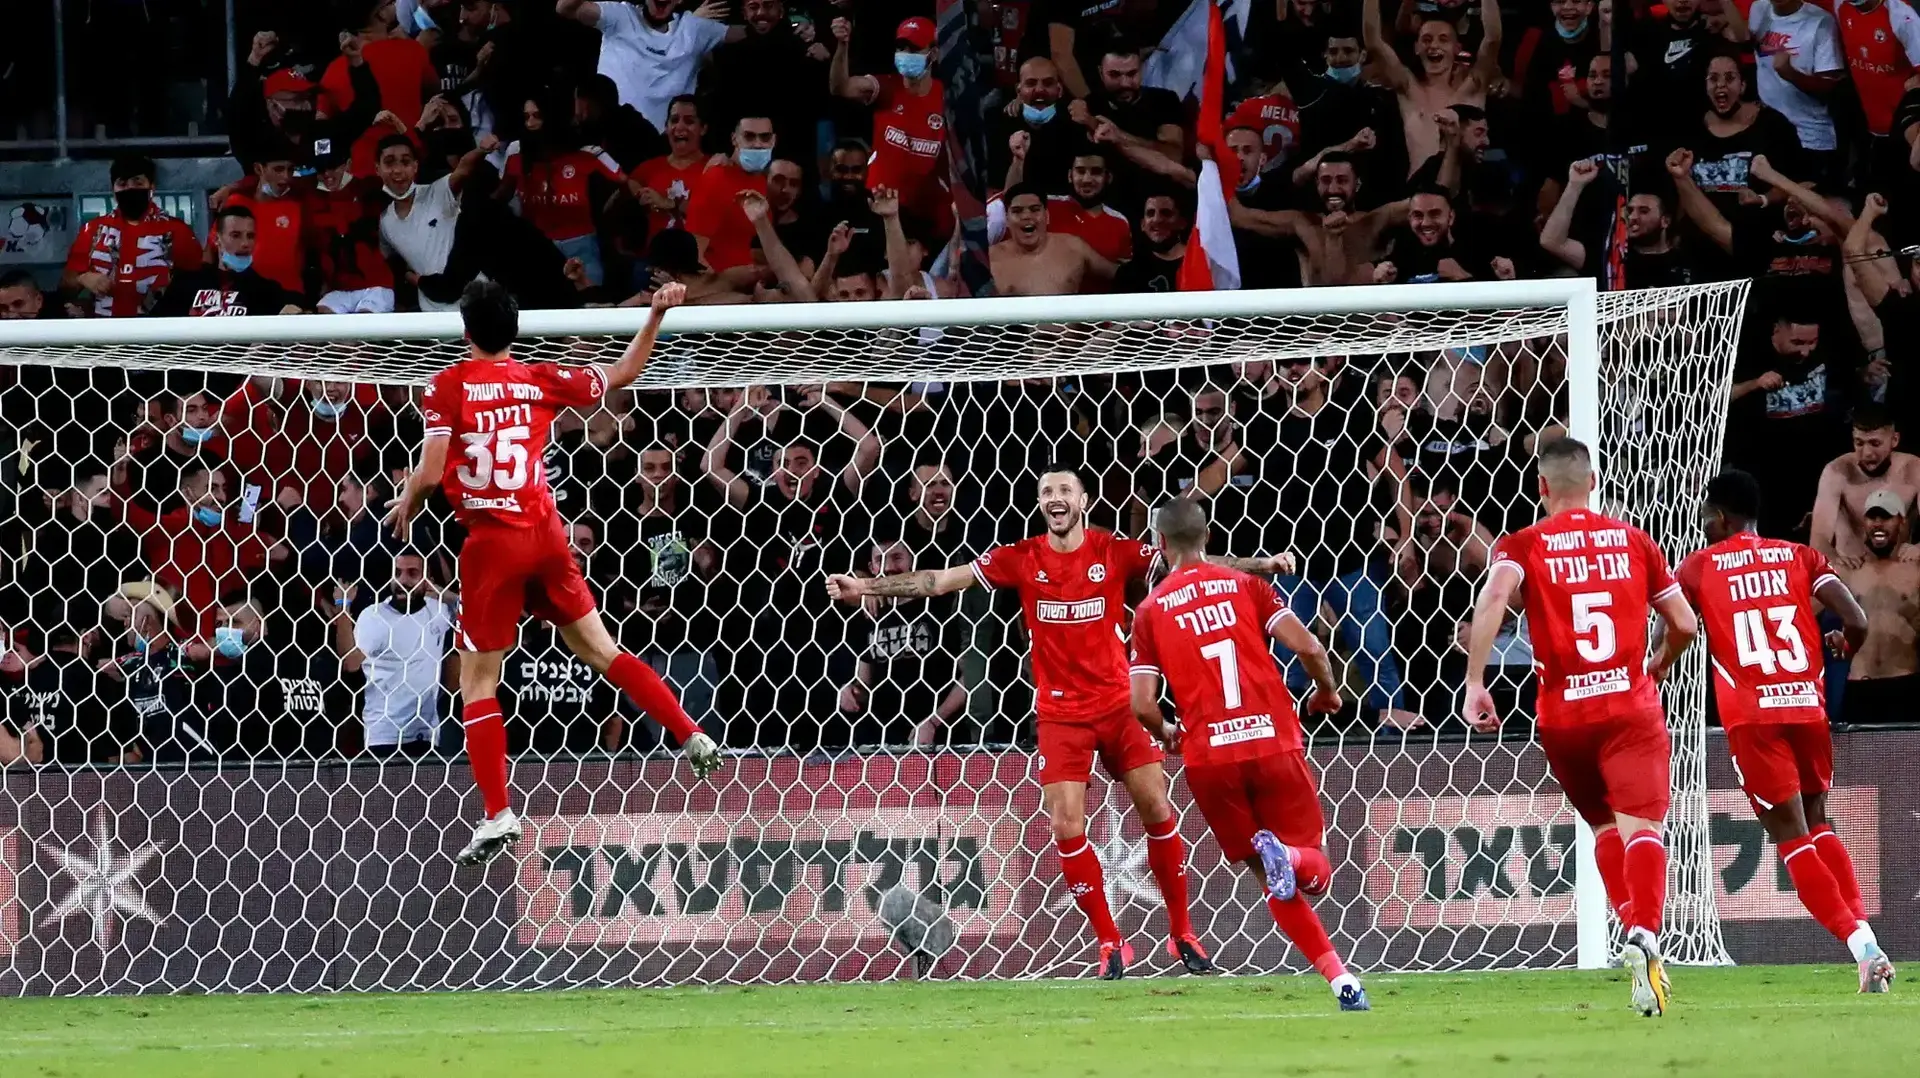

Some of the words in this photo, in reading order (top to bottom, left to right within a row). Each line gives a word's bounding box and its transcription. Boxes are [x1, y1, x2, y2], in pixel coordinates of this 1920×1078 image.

[462, 382, 505, 401] חשמל
[456, 426, 530, 490] 35
[1540, 530, 1586, 551] חשמל
[1589, 528, 1629, 548] מחסני
[1711, 549, 1754, 571] חשמל
[1757, 547, 1795, 564] מחסני
[1543, 552, 1632, 585] אבו-עביד
[1200, 578, 1238, 597] מחסני
[1727, 568, 1790, 602] אנסה
[1156, 582, 1199, 613] חשמל
[1040, 603, 1068, 621] השוק
[1071, 599, 1102, 619] מחסני
[1174, 600, 1238, 636] ספורי
[1571, 591, 1616, 663] 5
[1733, 605, 1809, 675] 43
[520, 661, 592, 681] ניצנים
[1200, 638, 1242, 710] 7
[1566, 666, 1629, 688] אביסרור
[519, 684, 593, 703] אבטחה
[1756, 681, 1817, 697] אביסרור
[1208, 714, 1273, 735] אביסרור
[542, 830, 988, 917] גולדסטאר
